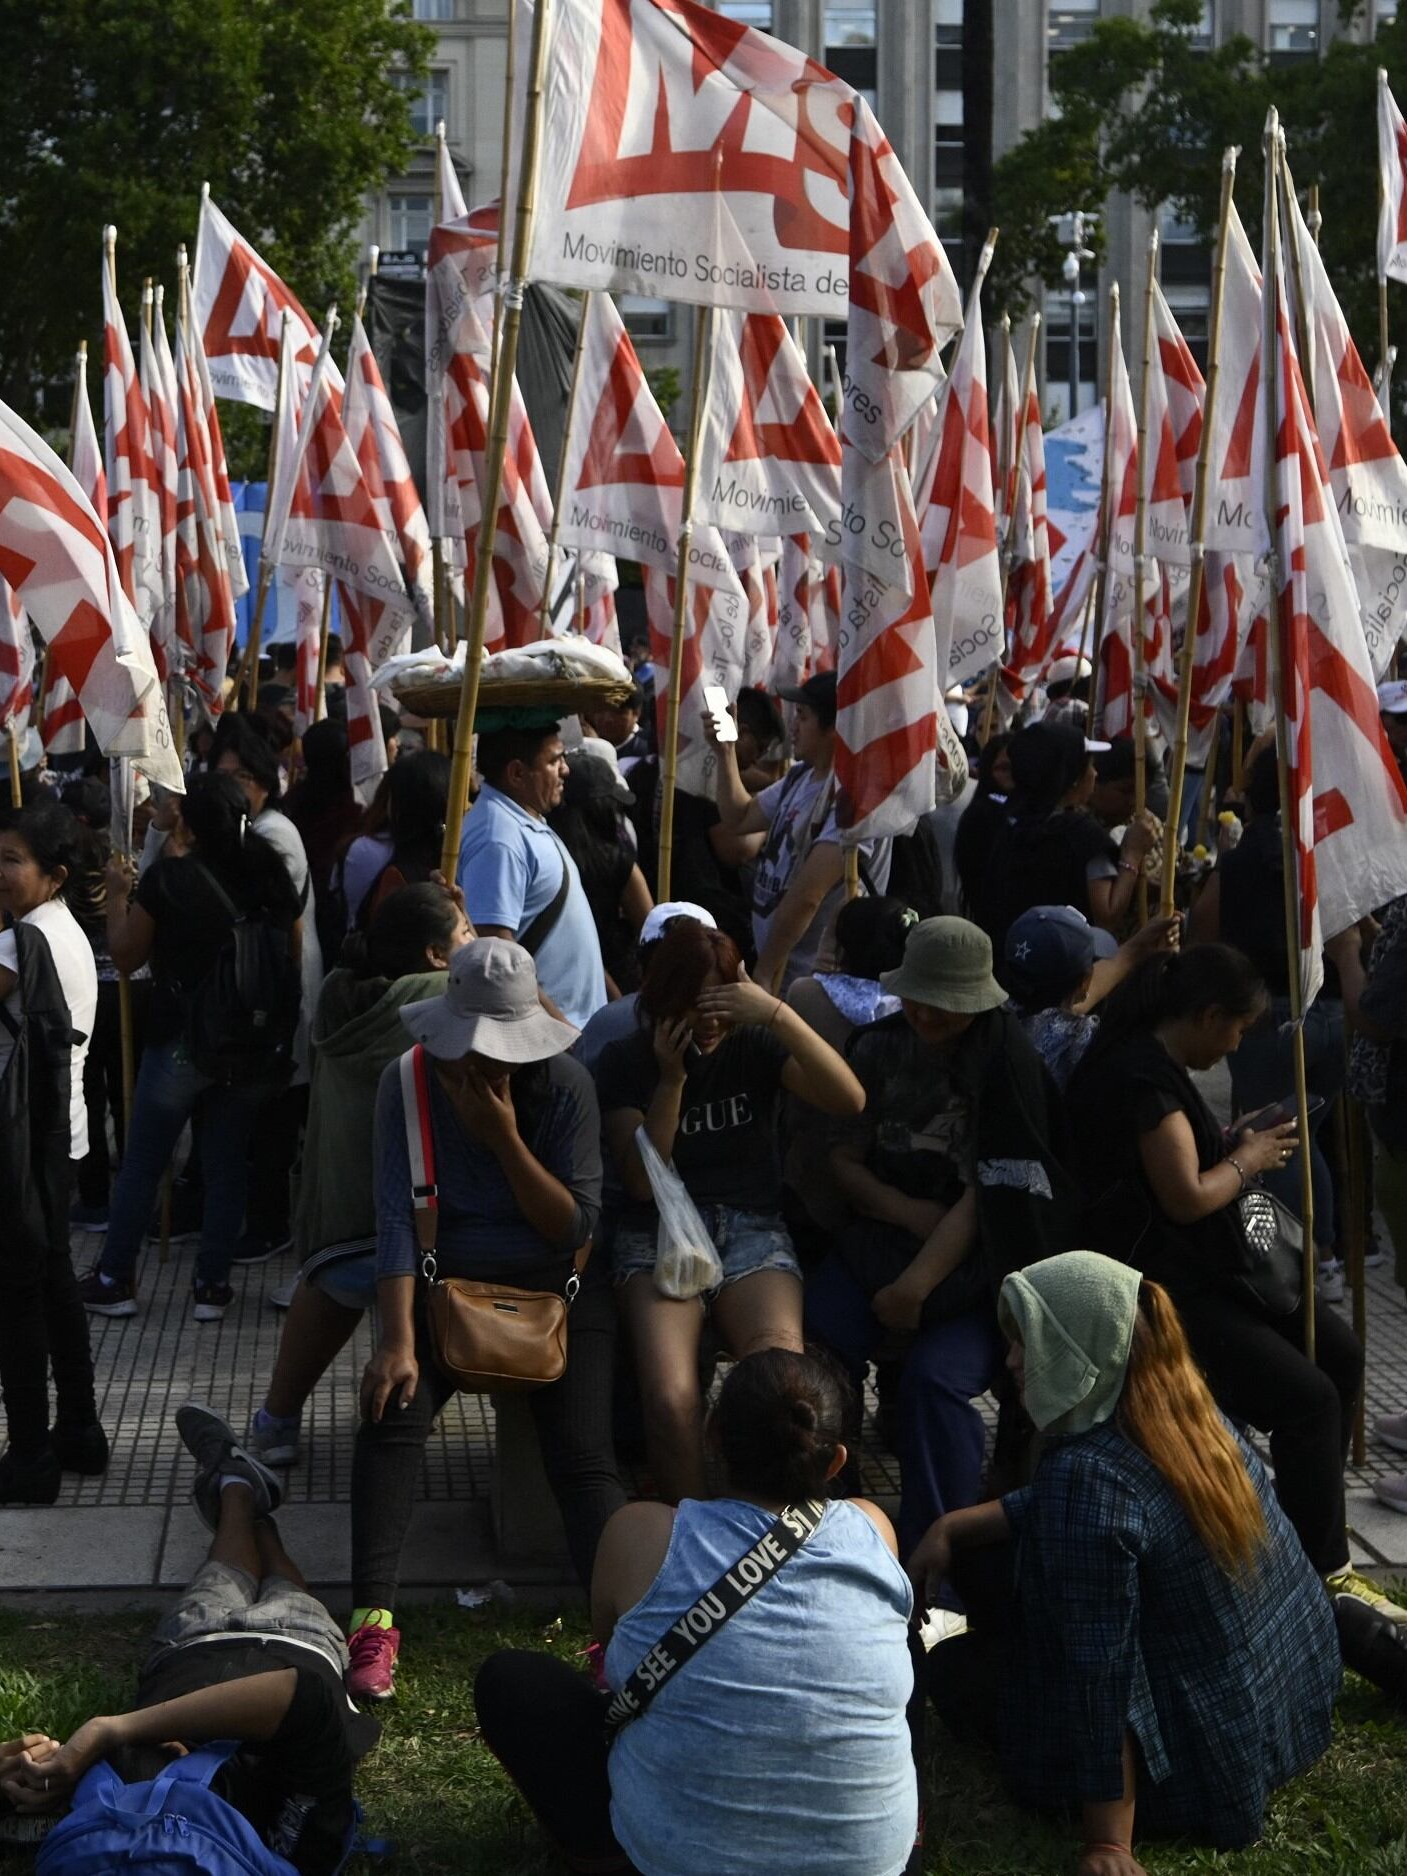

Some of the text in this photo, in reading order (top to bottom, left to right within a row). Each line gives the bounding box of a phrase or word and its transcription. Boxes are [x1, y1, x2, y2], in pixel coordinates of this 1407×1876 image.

[563, 232, 849, 296] Movimiento Socialista de
[570, 506, 668, 553] Movimiento
[636, 1643, 677, 1693] SEE
[672, 1591, 727, 1646] YOU
[724, 1532, 788, 1597] LOVE
